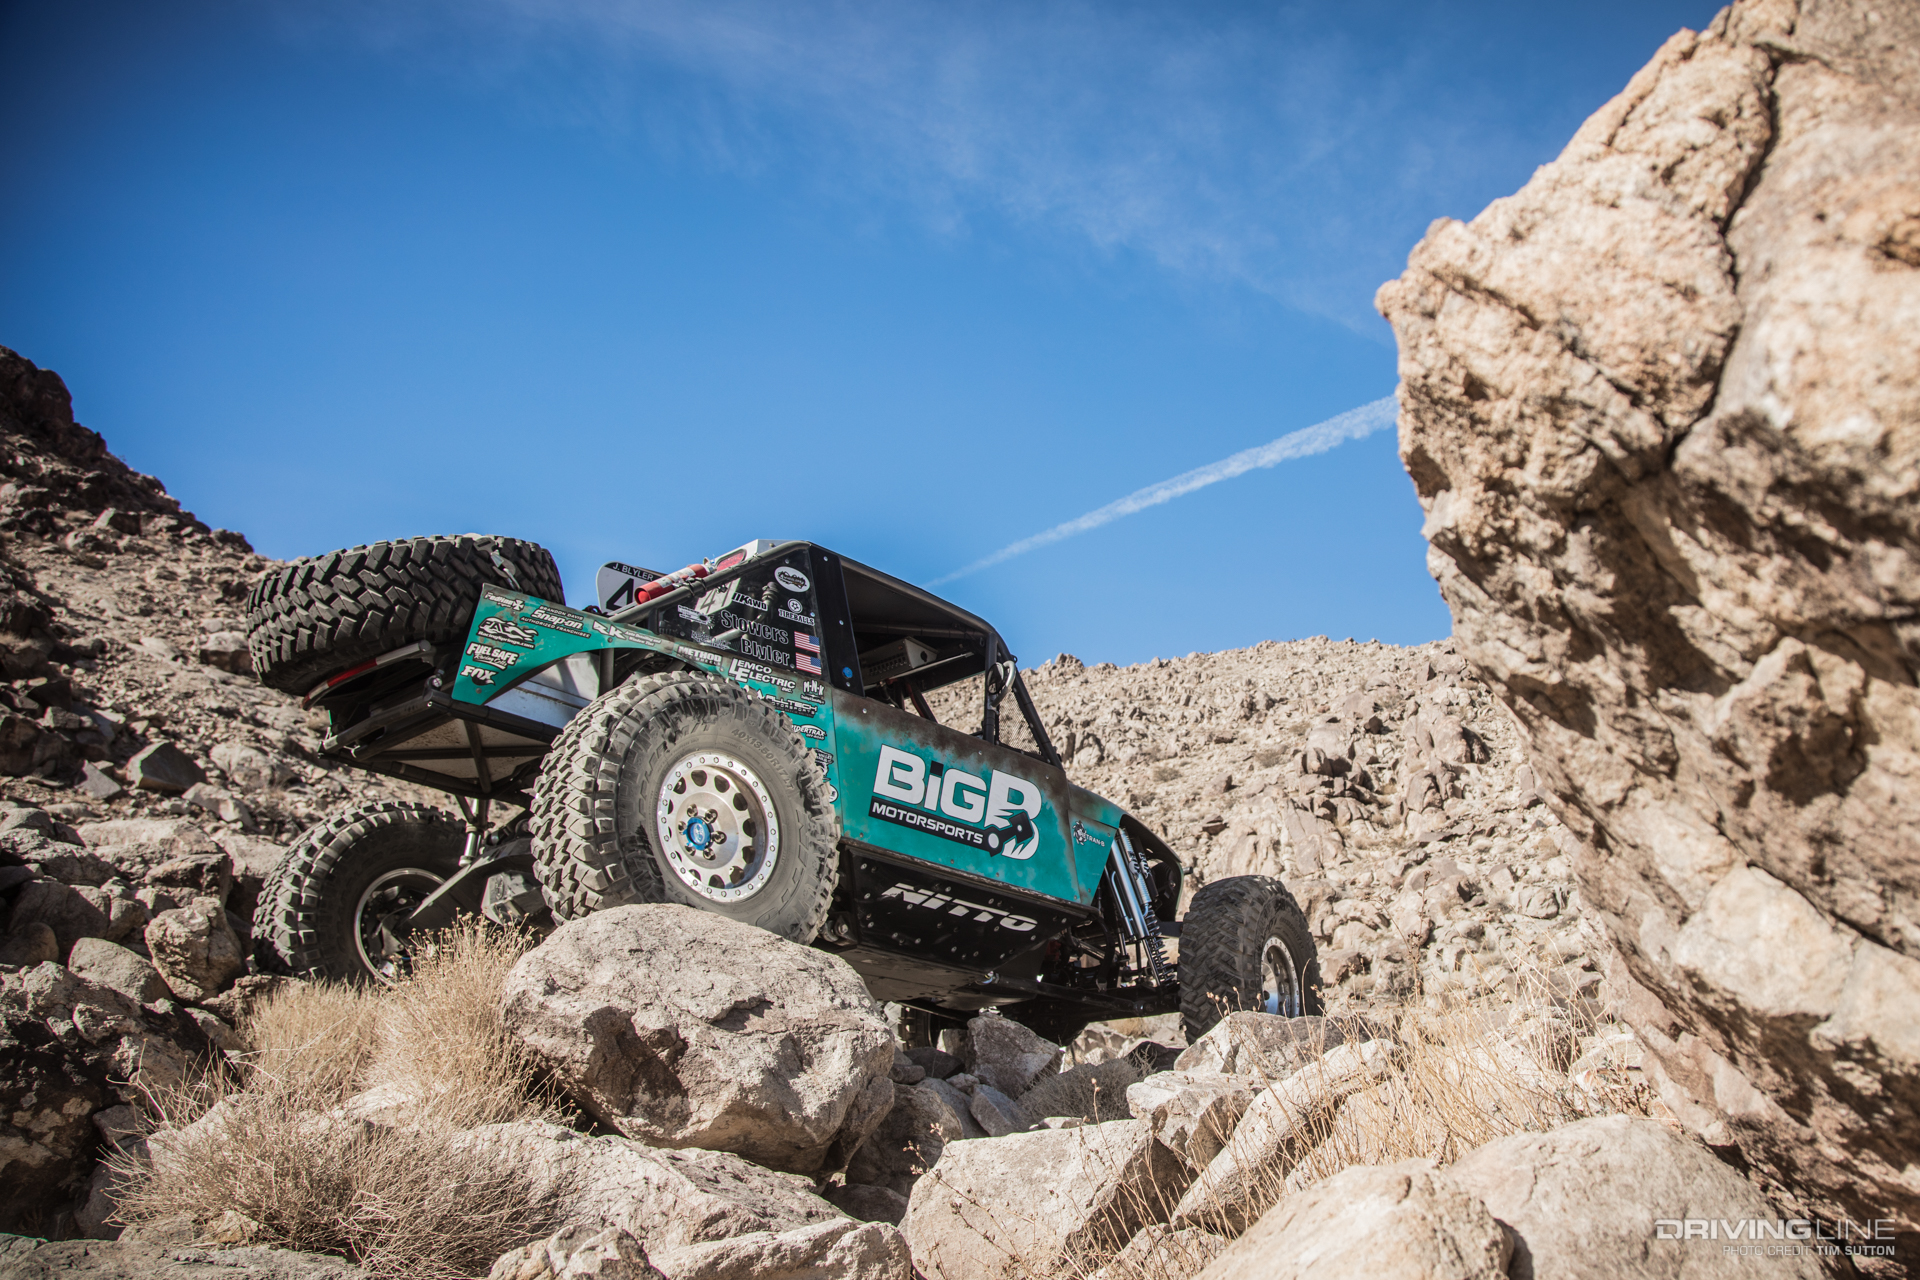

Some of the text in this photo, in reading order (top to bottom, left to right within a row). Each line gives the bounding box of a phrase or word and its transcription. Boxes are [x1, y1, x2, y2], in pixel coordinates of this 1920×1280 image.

[612, 563, 654, 581] J. BLYLER
[531, 609, 584, 630] Snap-on
[539, 605, 566, 617] BRANDON
[778, 608, 815, 626] TIREBALLS
[520, 616, 555, 629] AUTHORIZED
[720, 609, 789, 645] Stowers
[466, 643, 518, 665] FUEL SAFE
[678, 645, 722, 662] METHOD
[741, 638, 790, 666] Blyler
[460, 665, 497, 681] FOX
[728, 658, 772, 675] LEMCO
[735, 667, 796, 689] ELECTRIC
[771, 701, 815, 715] OTORSPORTS
[871, 801, 984, 845] MOTORSPORTS
